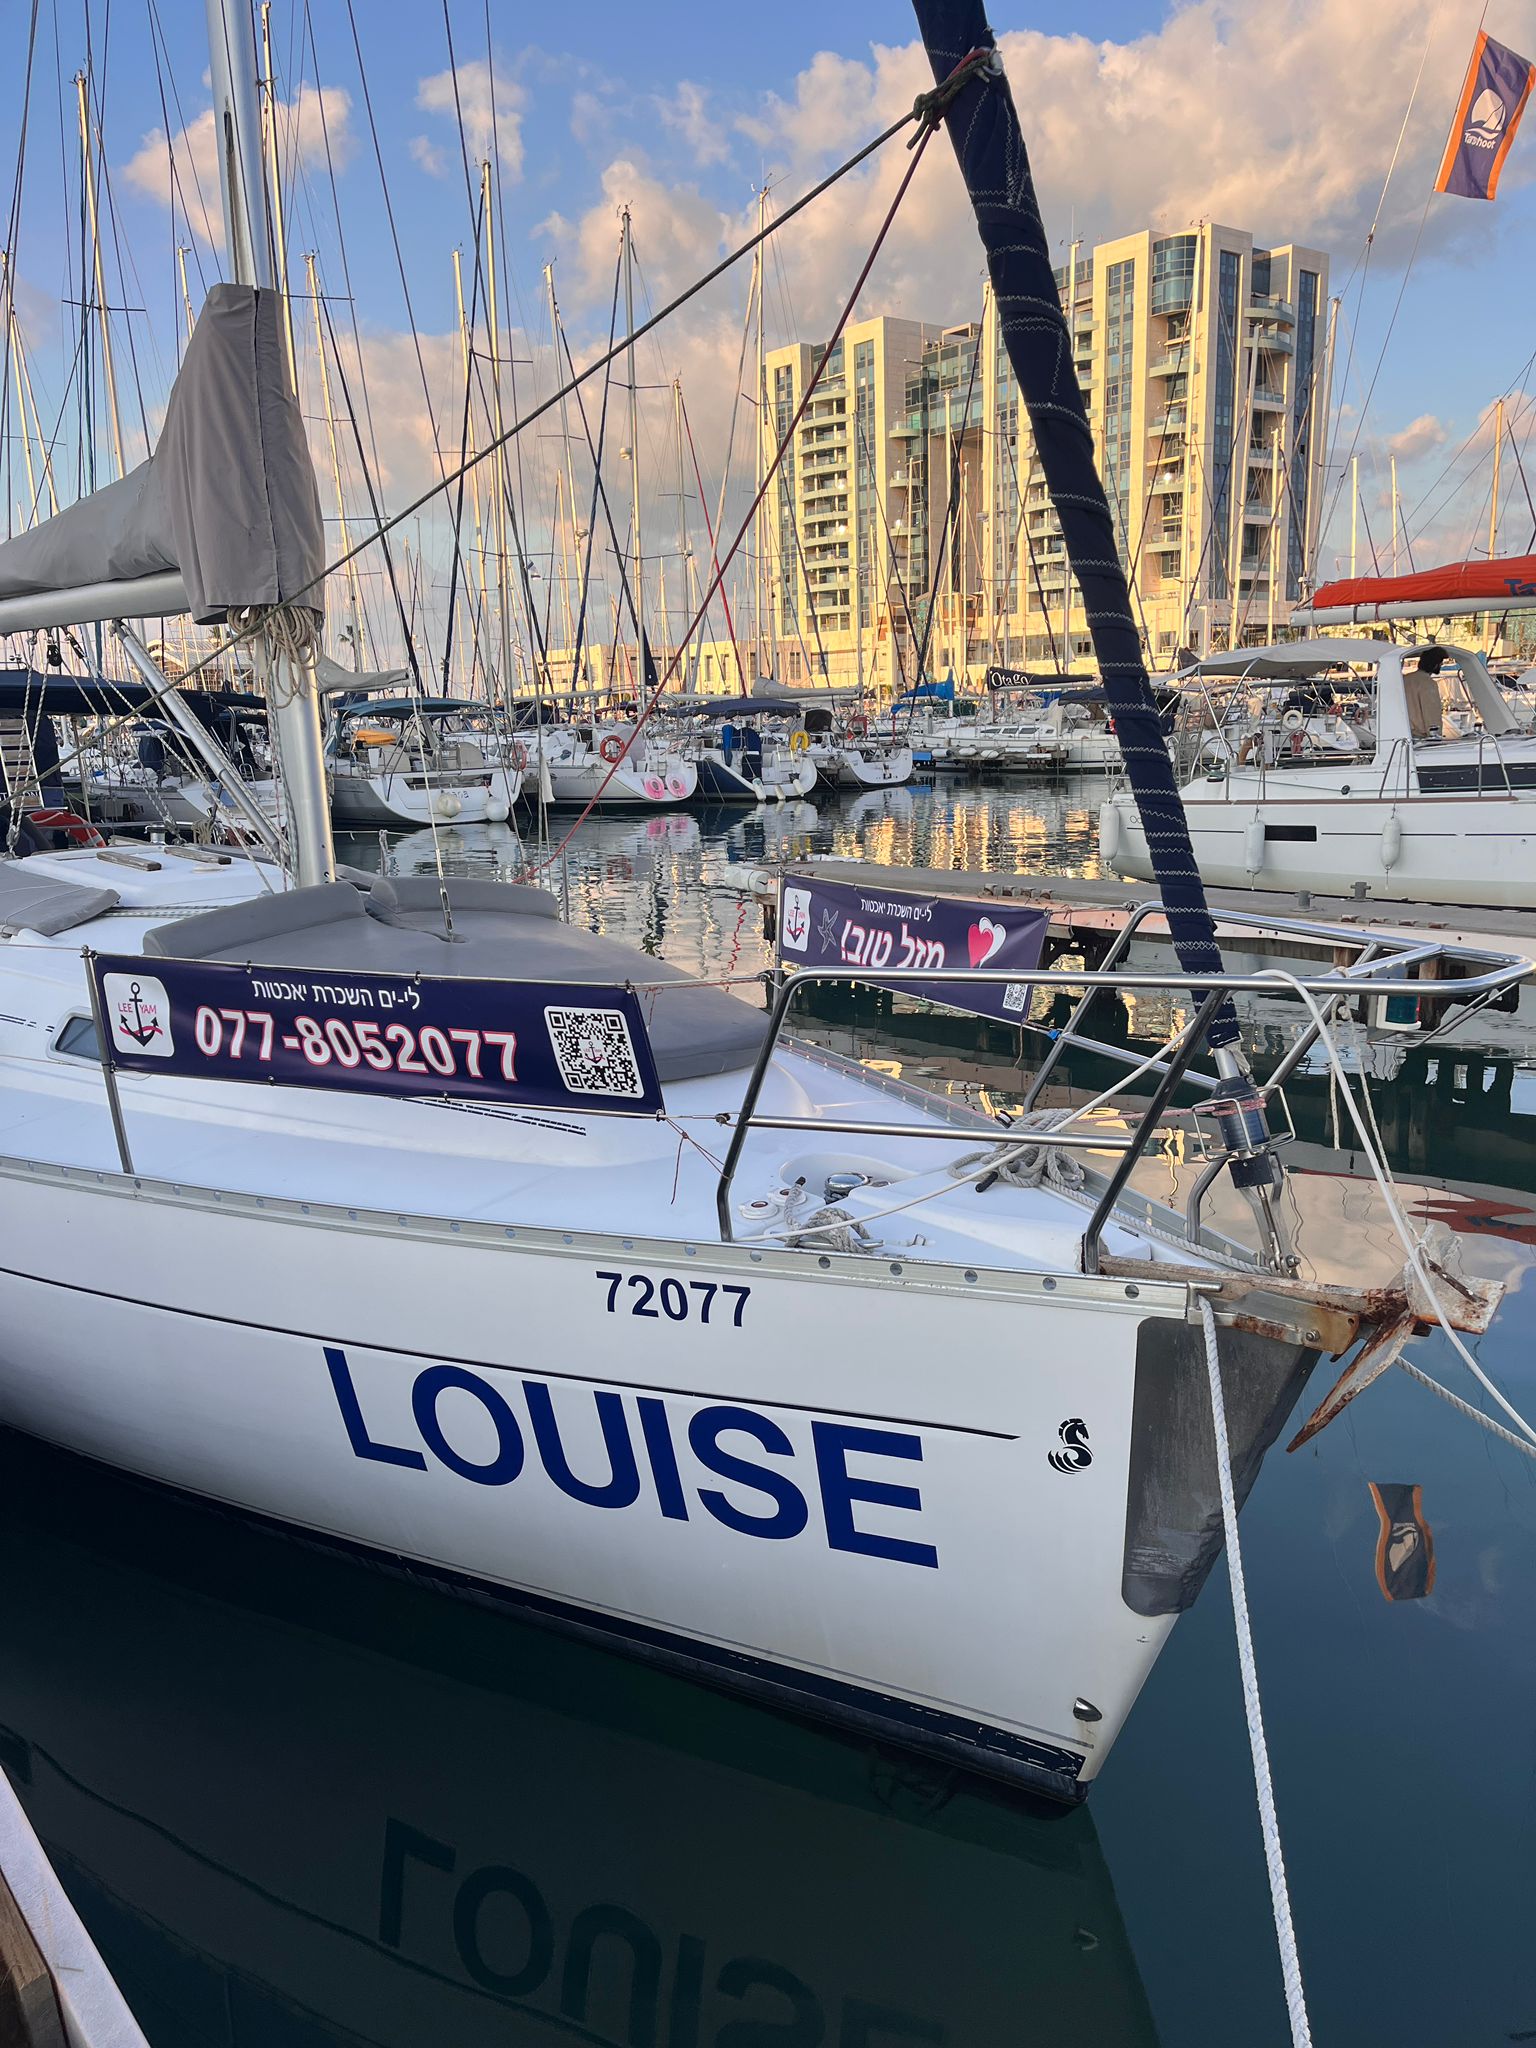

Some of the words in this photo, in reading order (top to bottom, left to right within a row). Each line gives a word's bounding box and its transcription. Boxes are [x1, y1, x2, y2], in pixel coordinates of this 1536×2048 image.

[991, 672, 1030, 687] Otago
[887, 903, 912, 920] השכרת
[840, 920, 894, 967] טוב!
[897, 922, 946, 968] מזל
[252, 980, 308, 1002] יאכטות
[312, 985, 374, 1007] השכרת
[379, 986, 421, 1010] לי-ים
[118, 1002, 133, 1012] LEE
[139, 1004, 157, 1014] YAM
[194, 1006, 519, 1082] 077-8052077
[596, 1271, 751, 1327] 72077
[322, 1347, 939, 1568] LOUISE
